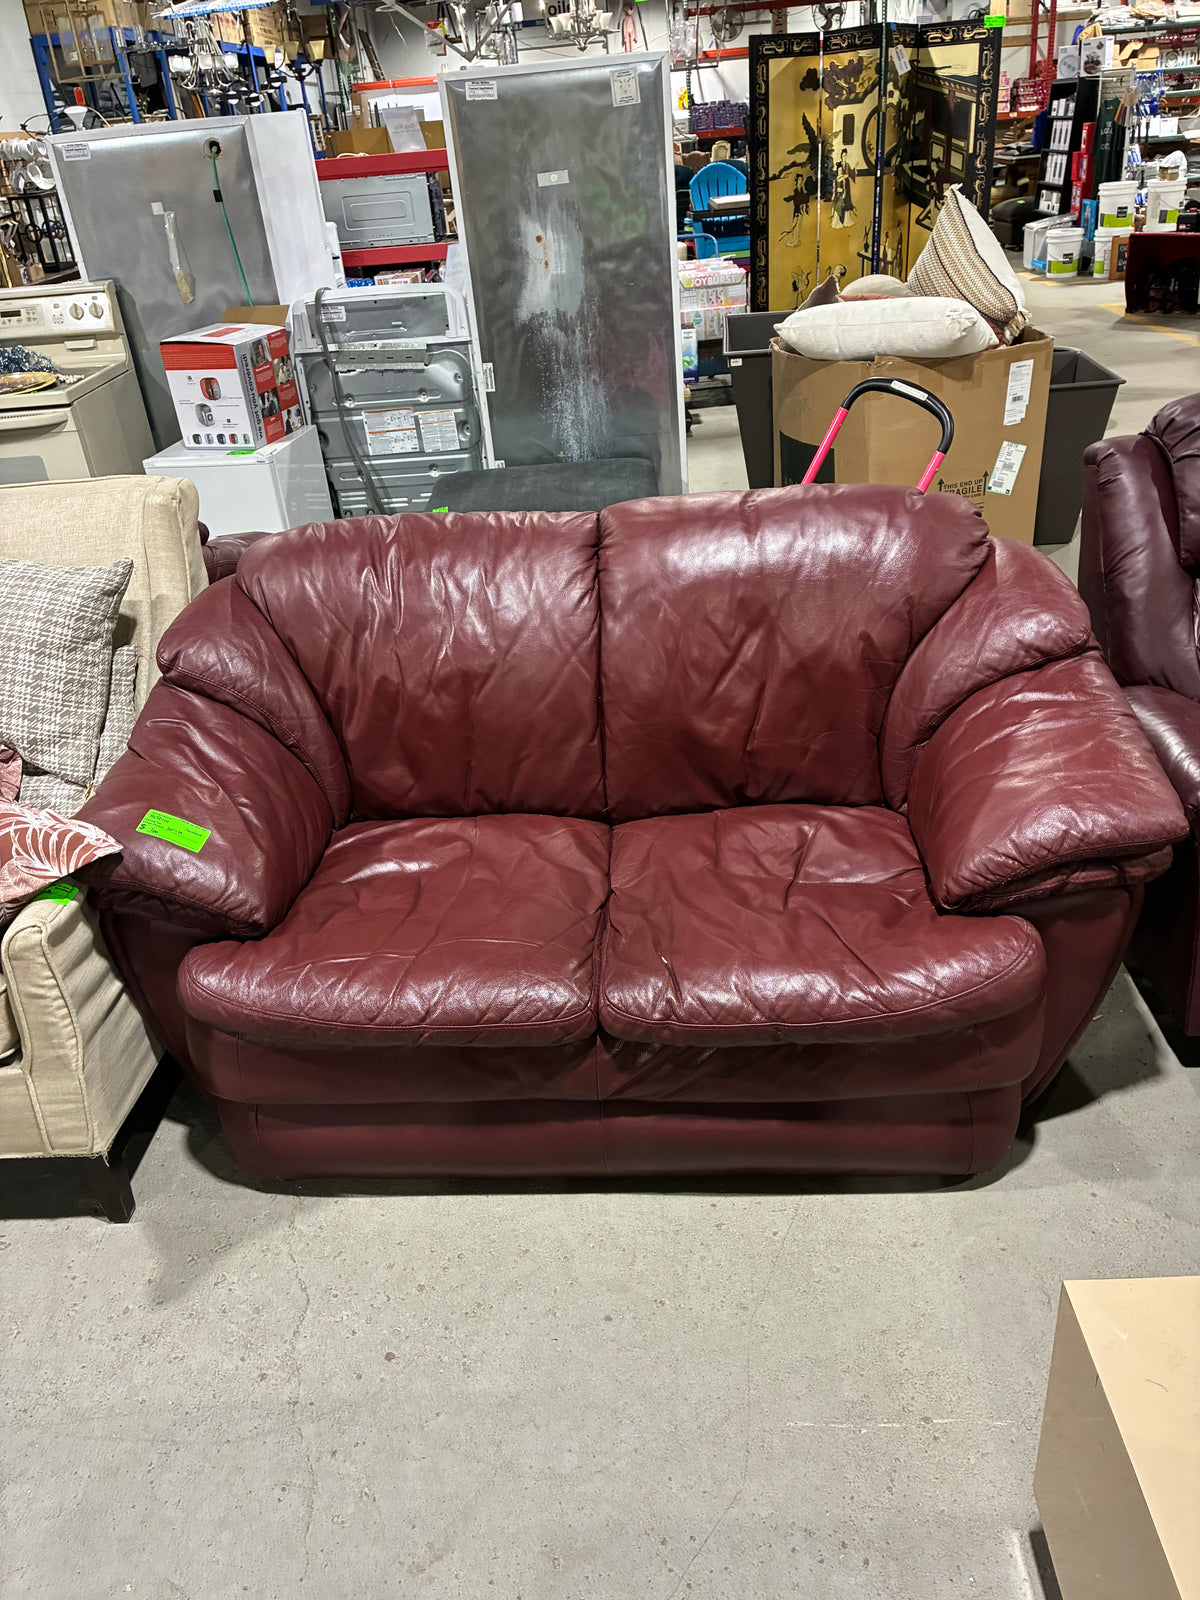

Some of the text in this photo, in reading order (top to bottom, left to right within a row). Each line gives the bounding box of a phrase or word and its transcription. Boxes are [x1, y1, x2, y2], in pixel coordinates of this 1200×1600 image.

[691, 275, 735, 287] JOYBURST
[241, 353, 253, 391] covered!
[944, 485, 982, 495] RAGILE
